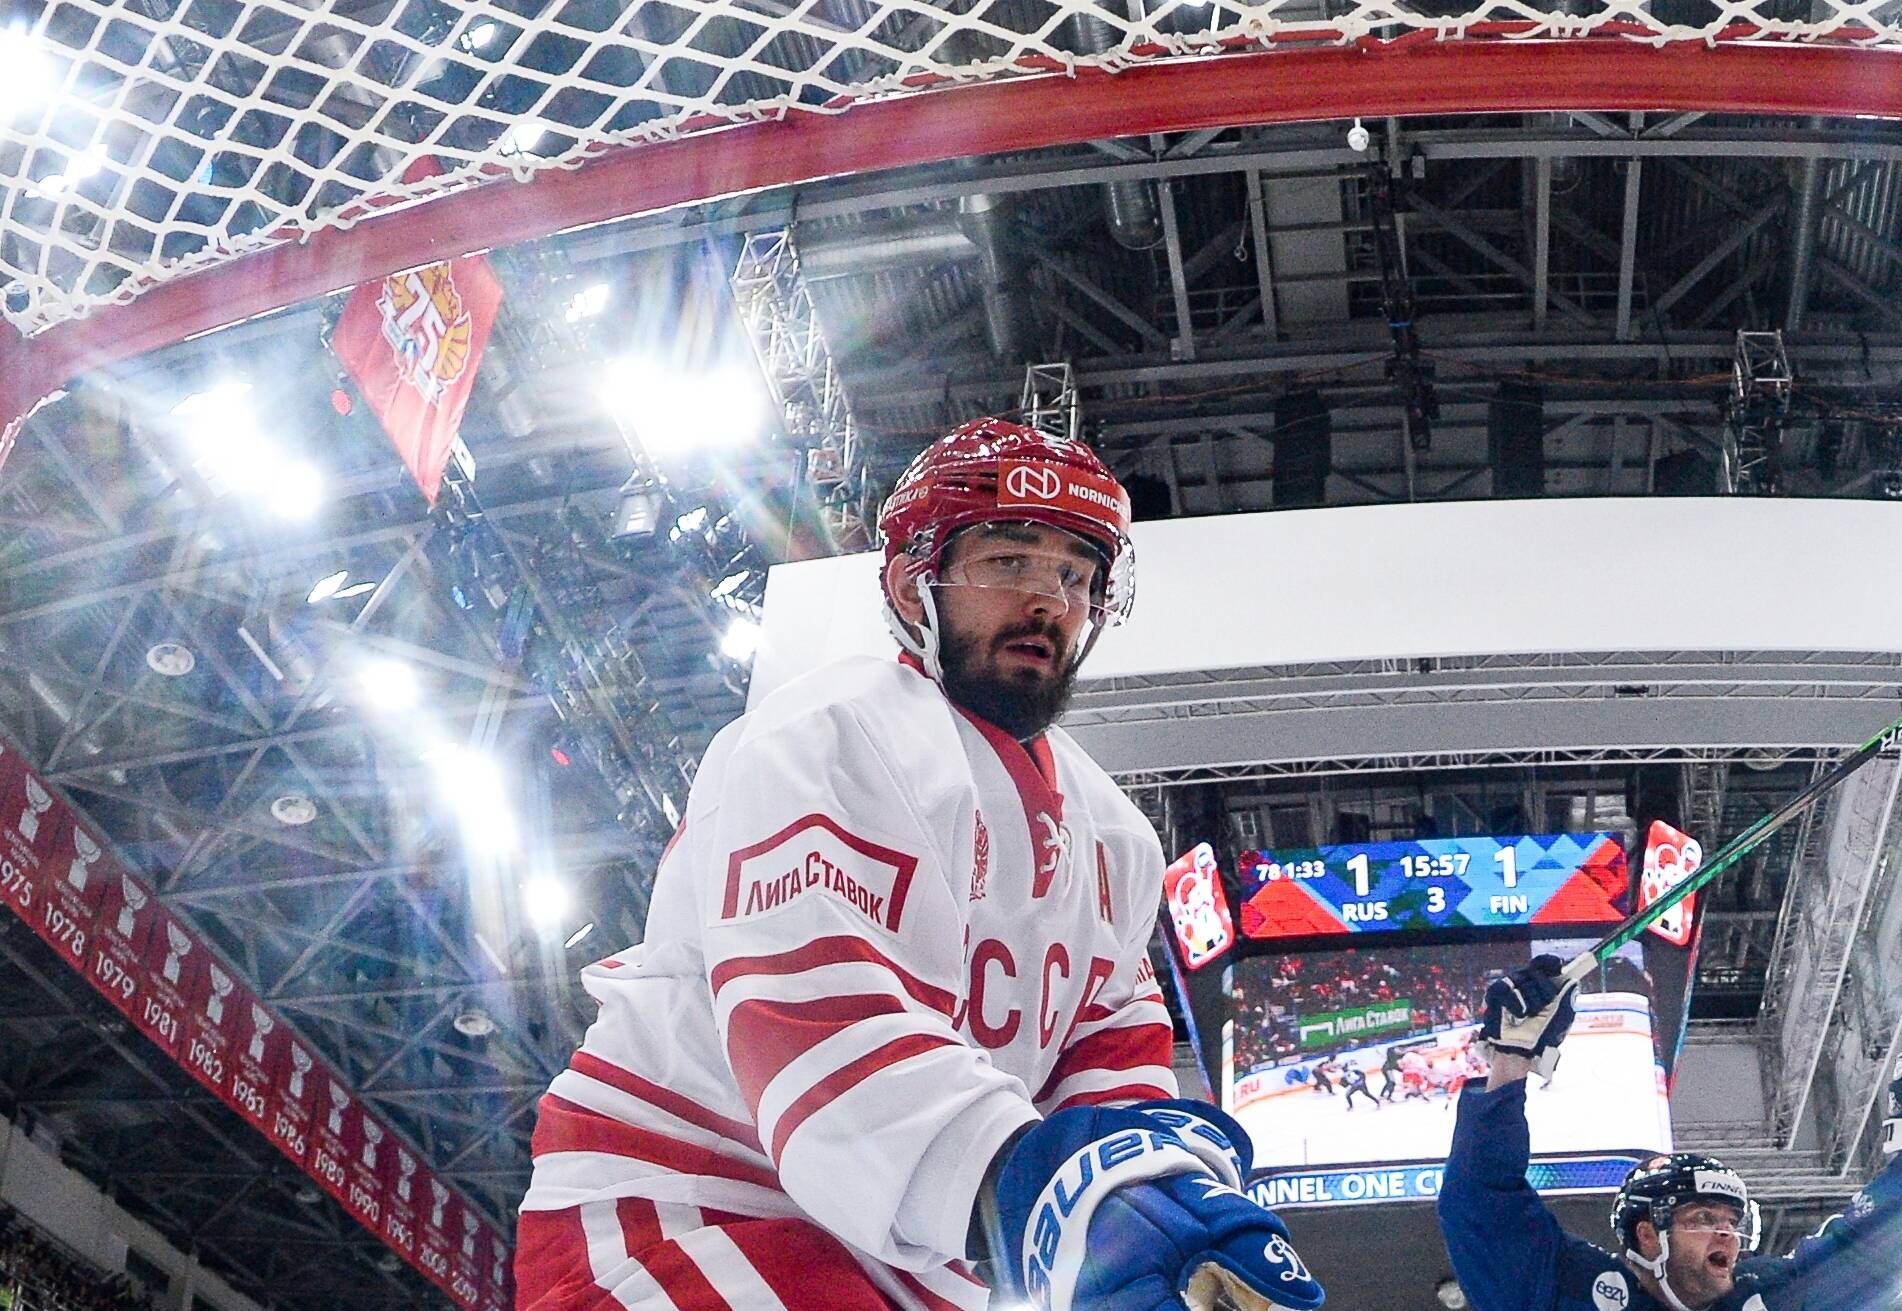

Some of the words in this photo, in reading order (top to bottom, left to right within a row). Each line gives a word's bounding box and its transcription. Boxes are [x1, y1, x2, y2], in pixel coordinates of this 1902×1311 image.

[0, 855, 33, 907] 975
[1346, 853, 1369, 896] 1
[1401, 853, 1471, 878] 15:57
[1493, 846, 1517, 888] 1
[1342, 902, 1389, 922] RUS
[1427, 887, 1445, 913] 3
[1489, 895, 1528, 915] FIN
[45, 902, 85, 957] 1978
[96, 951, 135, 998] 1979
[144, 998, 177, 1043] 1981
[189, 1038, 224, 1083] 1982
[1341, 1171, 1407, 1201] ONE
